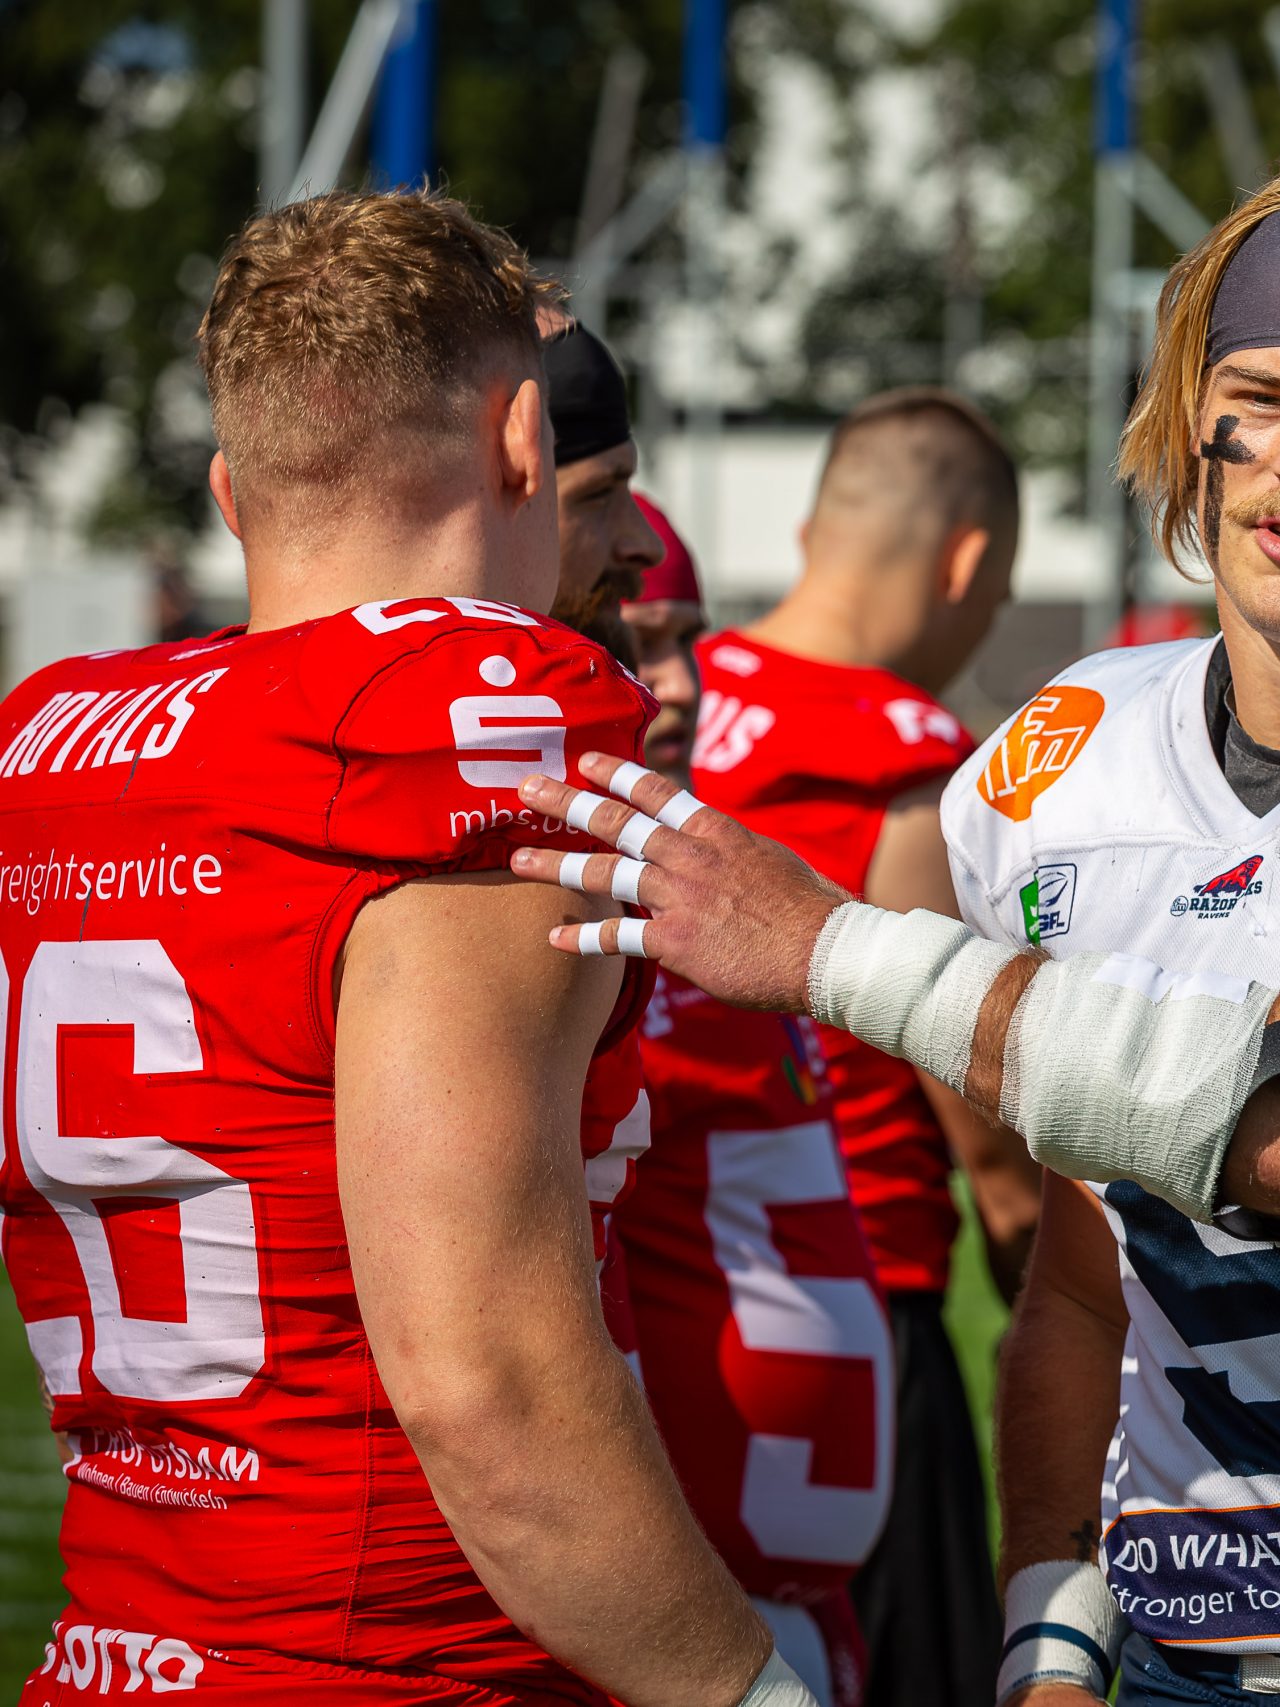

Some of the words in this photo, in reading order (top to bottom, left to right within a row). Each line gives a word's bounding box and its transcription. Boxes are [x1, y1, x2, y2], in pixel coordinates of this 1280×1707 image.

[0, 667, 231, 779] ROYALS
[0, 842, 223, 916] reightservice
[0, 938, 266, 1402] 6
[706, 1118, 898, 1566] 5
[77, 1461, 114, 1491] Wohnen
[120, 1476, 150, 1501] Bauen
[155, 1484, 228, 1510] Entwickeln
[1112, 1536, 1158, 1574] DO
